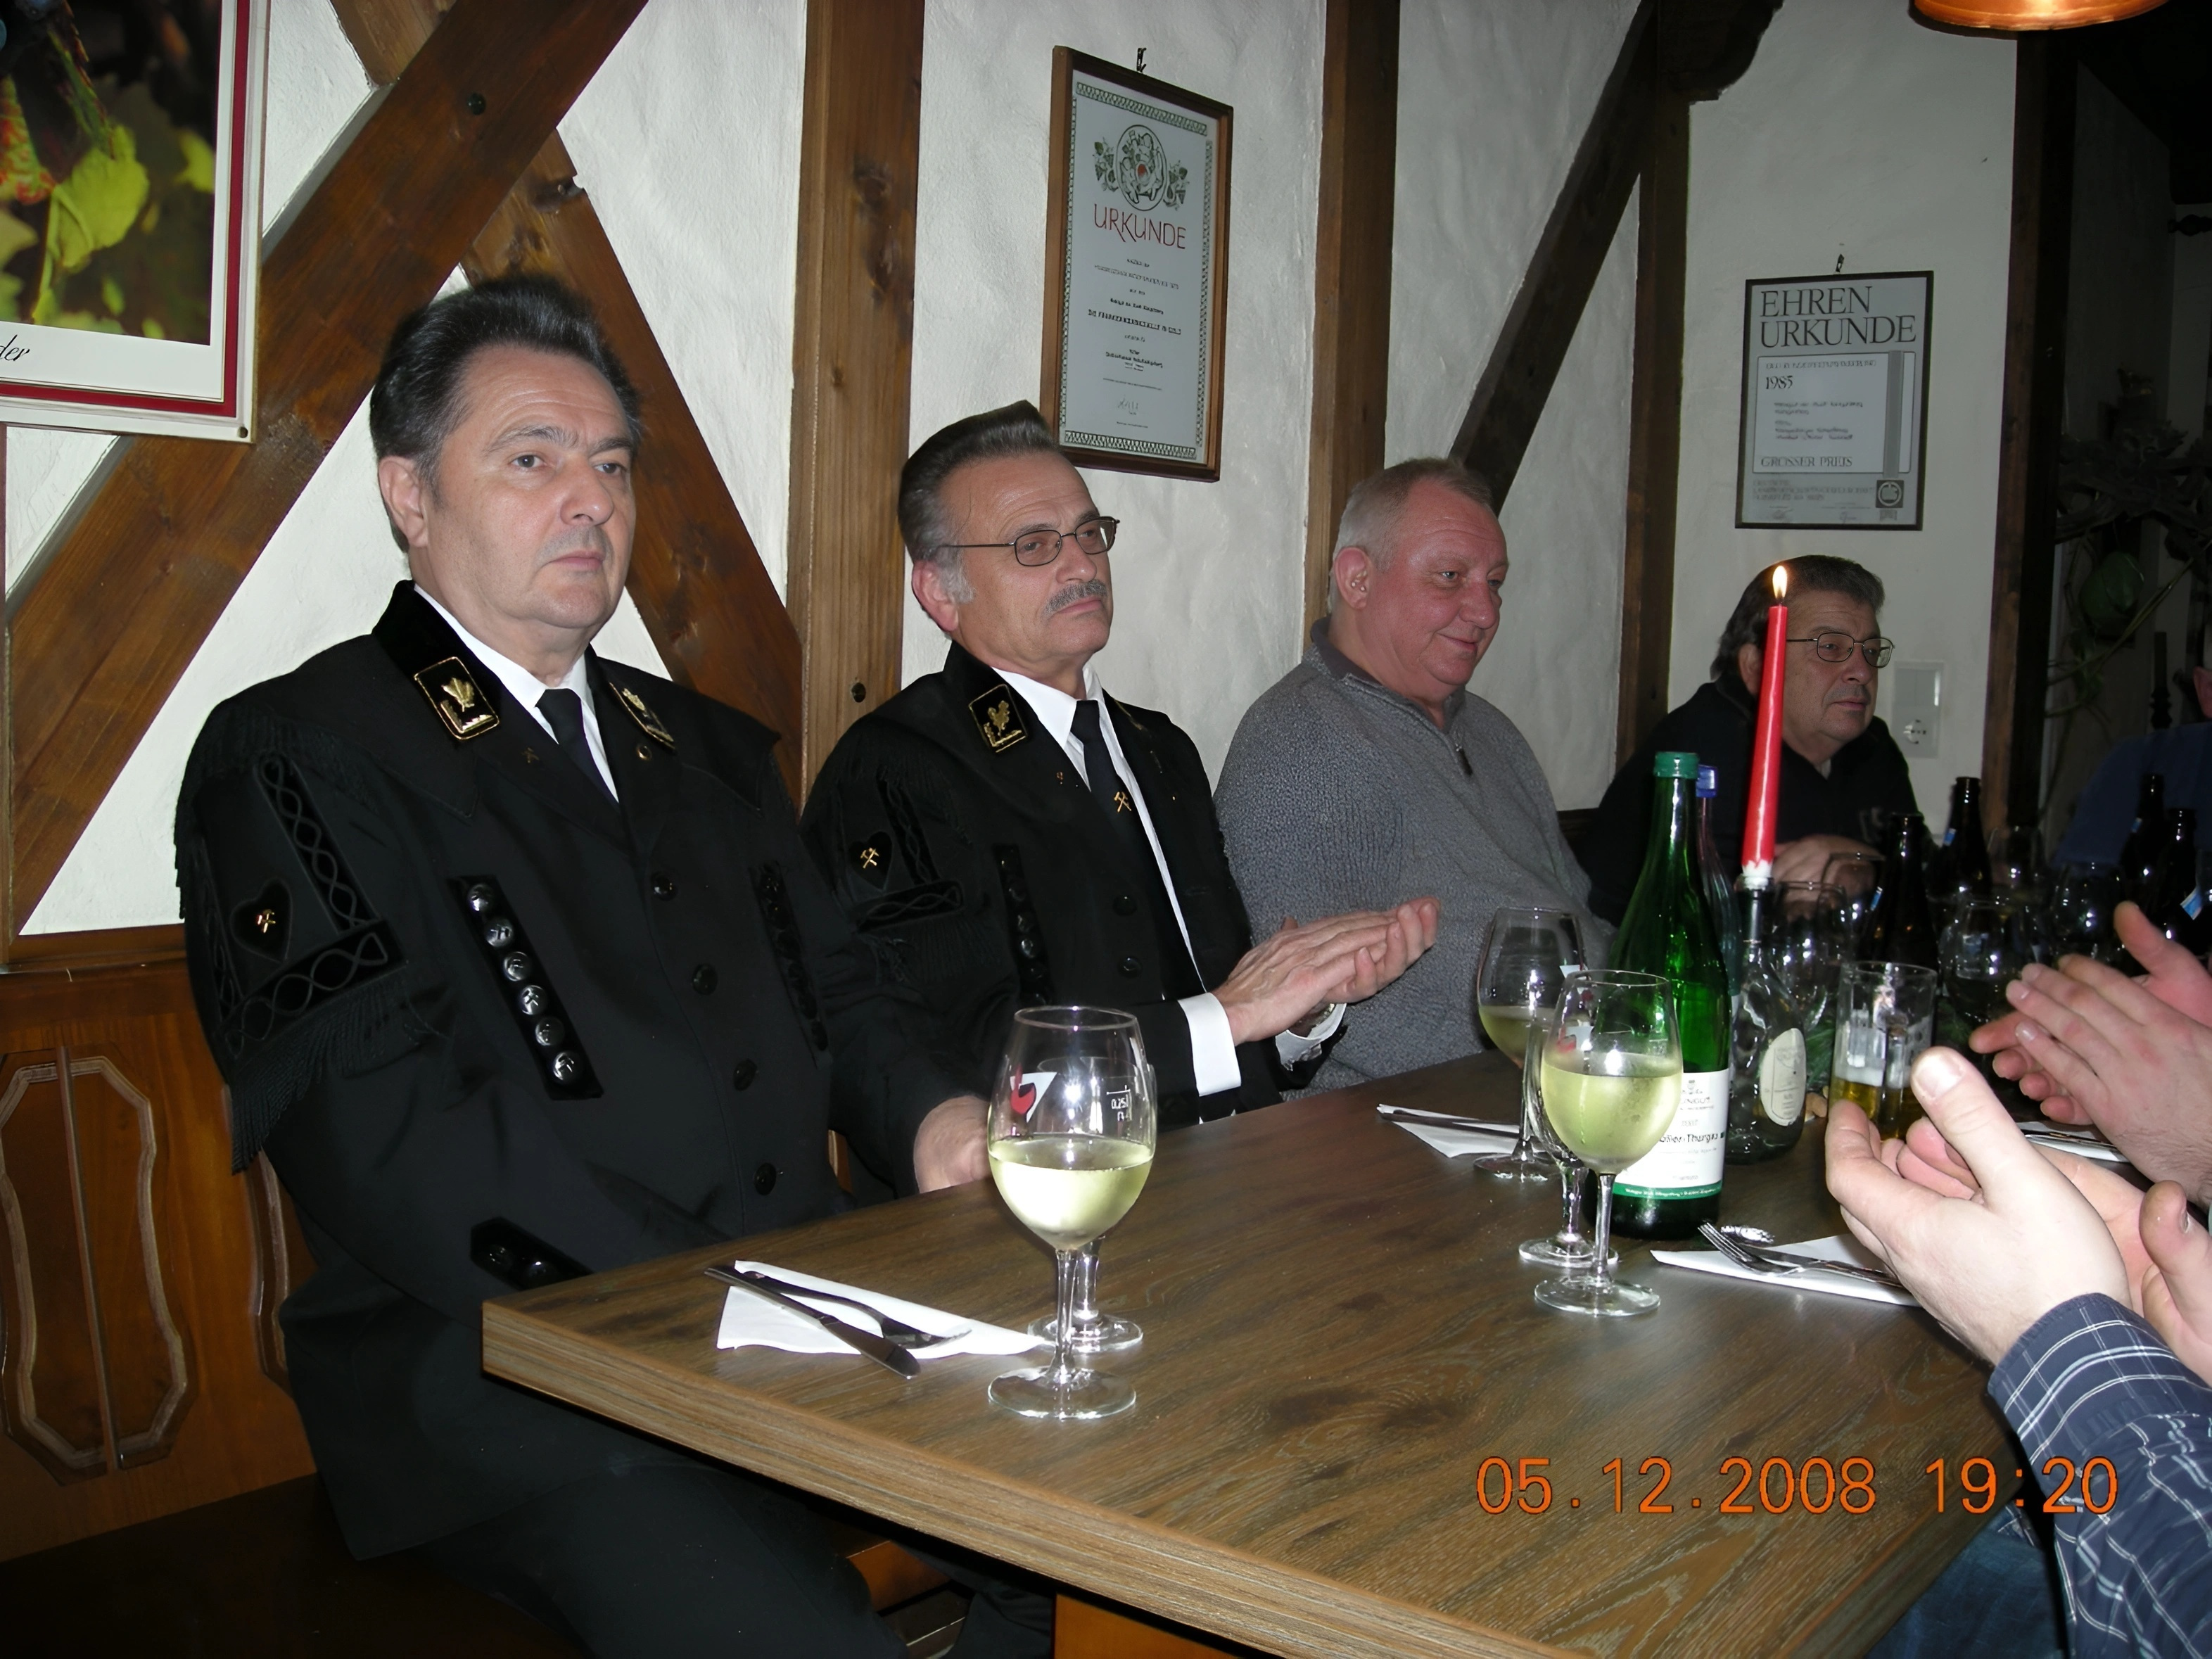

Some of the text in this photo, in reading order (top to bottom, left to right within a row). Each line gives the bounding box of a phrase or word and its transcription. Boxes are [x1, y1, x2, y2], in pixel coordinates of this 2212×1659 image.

[1093, 203, 1186, 250] URKUNDE
[1760, 286, 1872, 317] EHREN
[1760, 315, 1917, 348] URKUNDE
[1765, 375, 1793, 389] 1985
